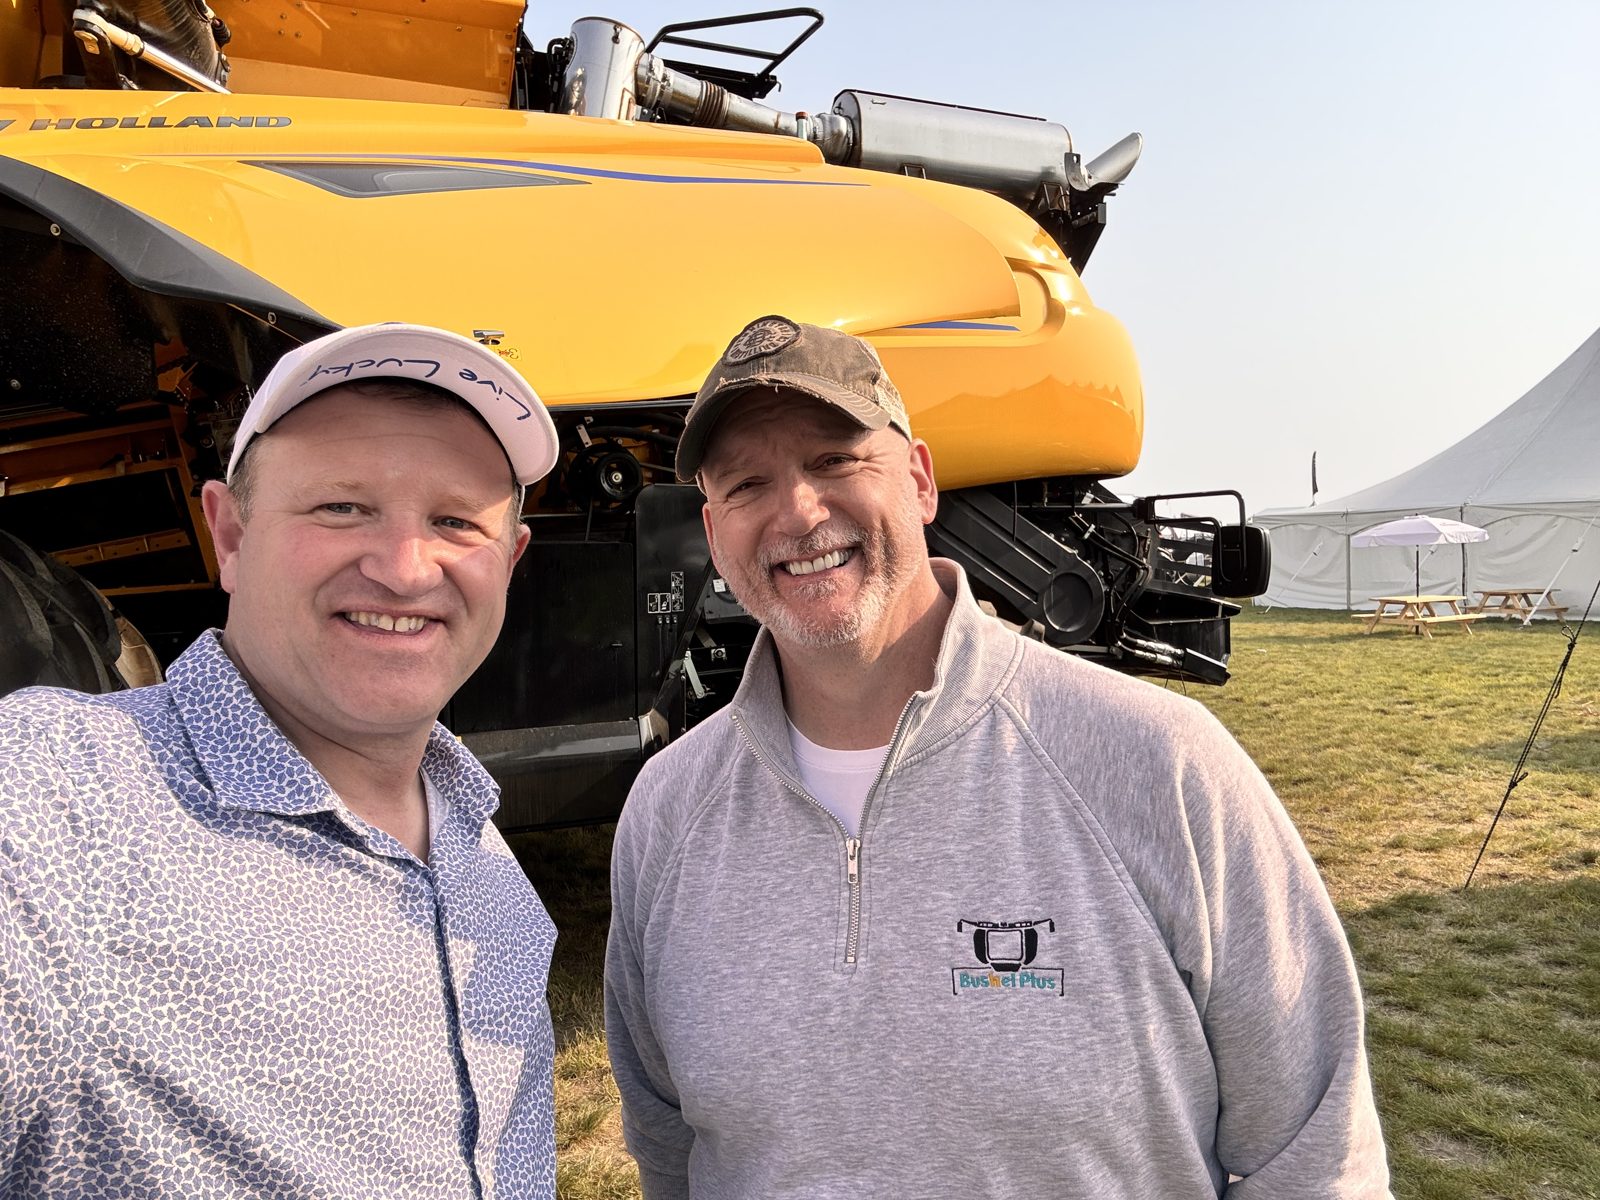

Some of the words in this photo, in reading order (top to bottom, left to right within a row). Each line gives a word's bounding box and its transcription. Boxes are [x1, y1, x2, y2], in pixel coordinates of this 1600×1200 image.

[29, 116, 292, 131] HOLLAND
[299, 358, 441, 387] Lucky
[459, 368, 531, 421] Live
[959, 971, 1016, 988] Bushel
[1019, 971, 1056, 989] Plus
